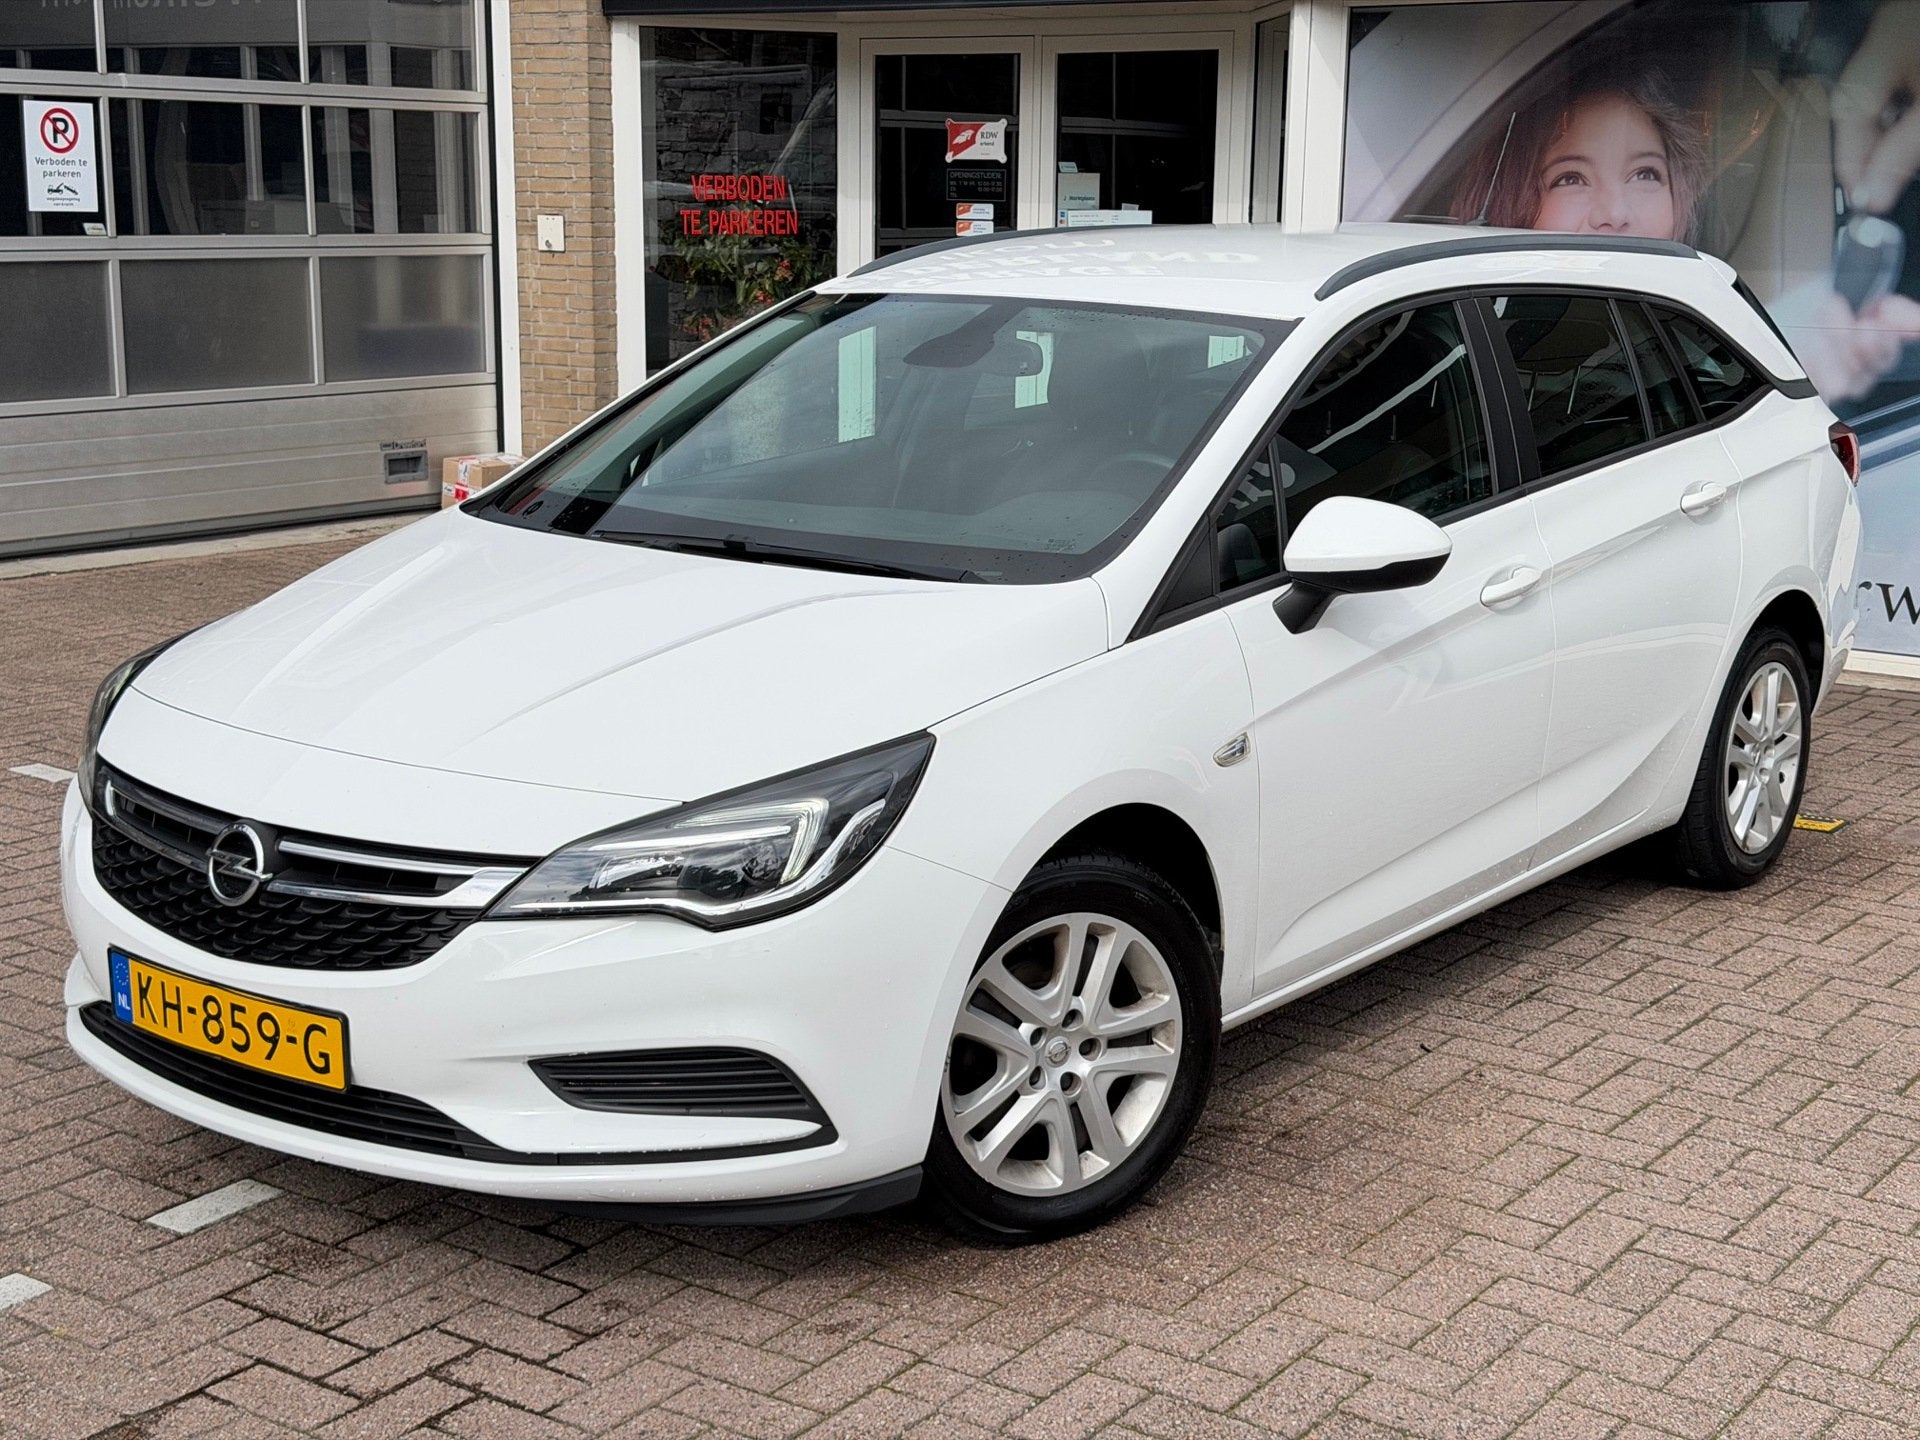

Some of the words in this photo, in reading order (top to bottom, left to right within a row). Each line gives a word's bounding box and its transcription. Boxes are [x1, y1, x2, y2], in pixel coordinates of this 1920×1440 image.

[52, 117, 69, 144] P
[980, 131, 999, 139] RDW
[35, 156, 76, 166] Verboden
[42, 169, 82, 179] parkeren
[690, 174, 787, 201] VERBODEN
[680, 209, 702, 235] TE
[707, 209, 799, 236] PARKEREN
[118, 991, 131, 1011] NL
[137, 971, 331, 1075] KH-859-G
